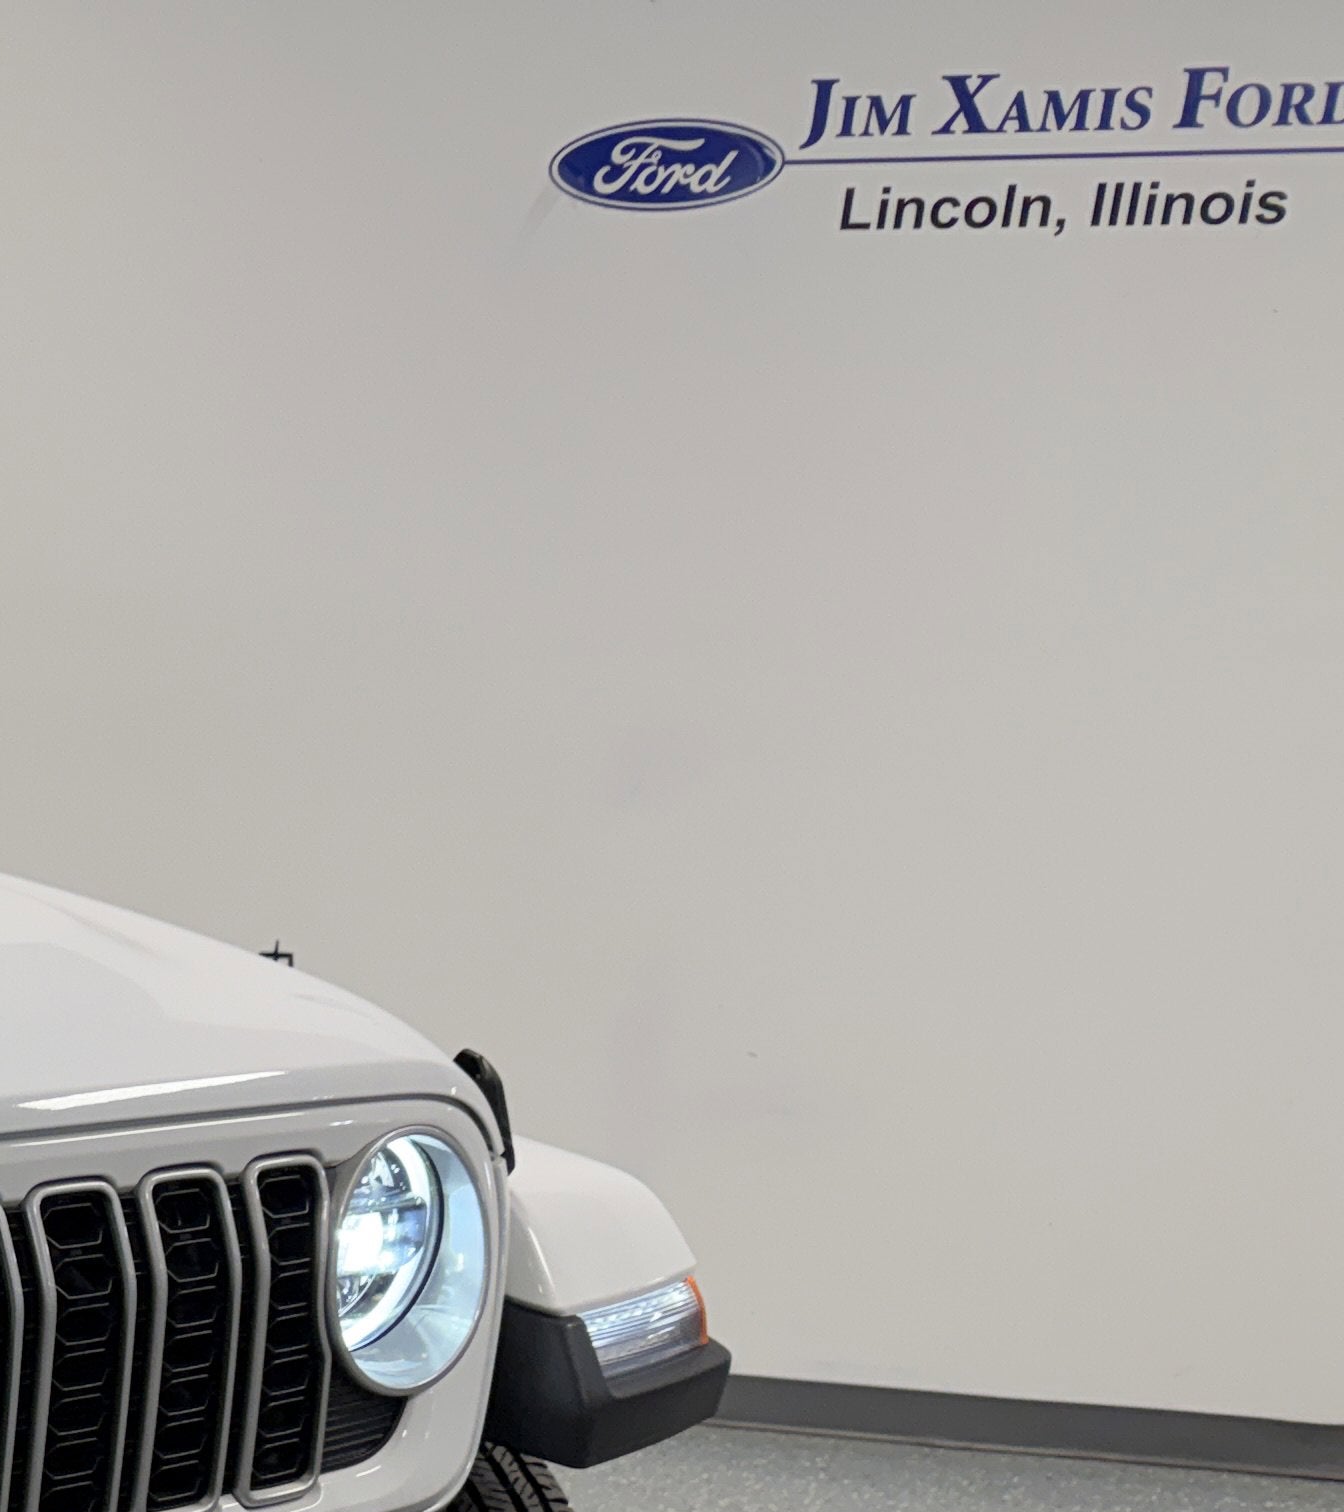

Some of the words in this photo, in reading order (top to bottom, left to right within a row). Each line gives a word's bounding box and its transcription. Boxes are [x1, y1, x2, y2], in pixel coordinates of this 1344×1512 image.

[799, 78, 916, 149] JIM
[931, 74, 1155, 136] XAMIS
[593, 135, 739, 195] Ford
[839, 184, 1067, 236] Lincoln,
[1090, 180, 1289, 228] Illinois
